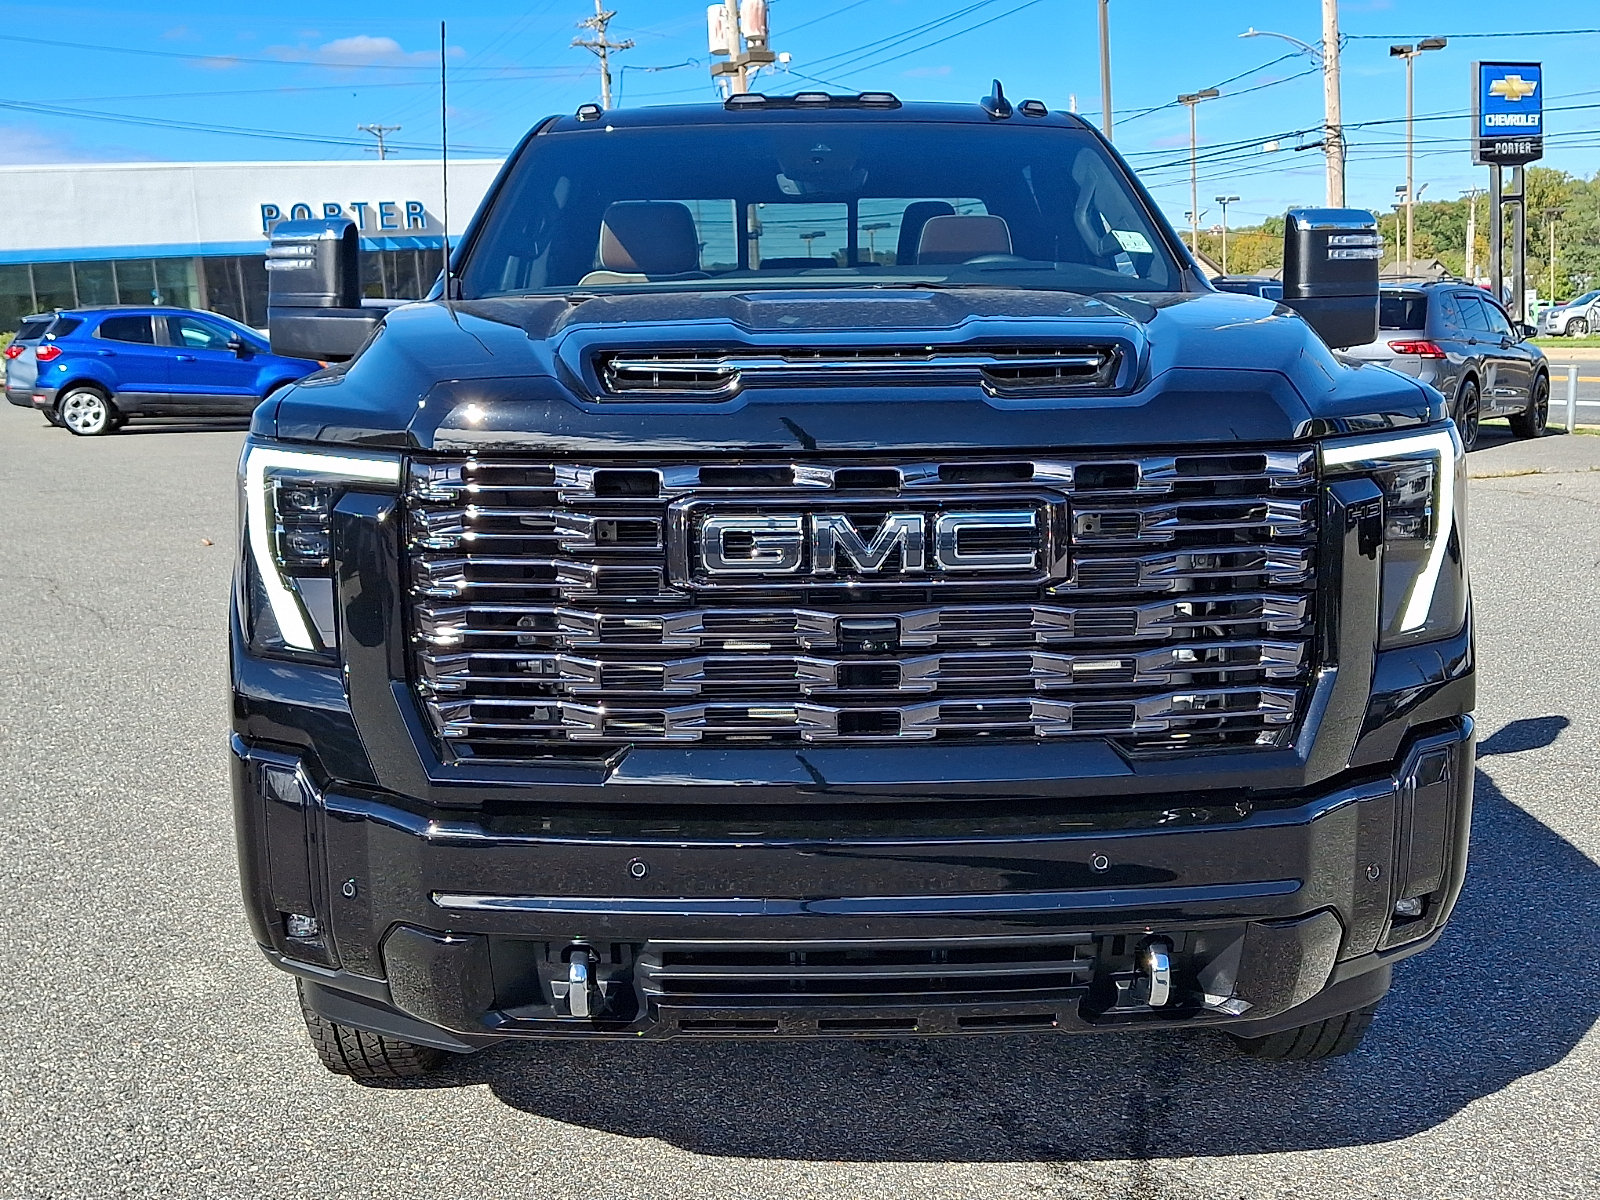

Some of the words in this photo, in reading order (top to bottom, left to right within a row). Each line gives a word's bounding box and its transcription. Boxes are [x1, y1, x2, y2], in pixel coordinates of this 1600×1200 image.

[1485, 114, 1540, 126] CHEVROLET
[1495, 142, 1531, 154] PORTER
[1347, 502, 1381, 522] HD
[702, 509, 1038, 574] GMC
